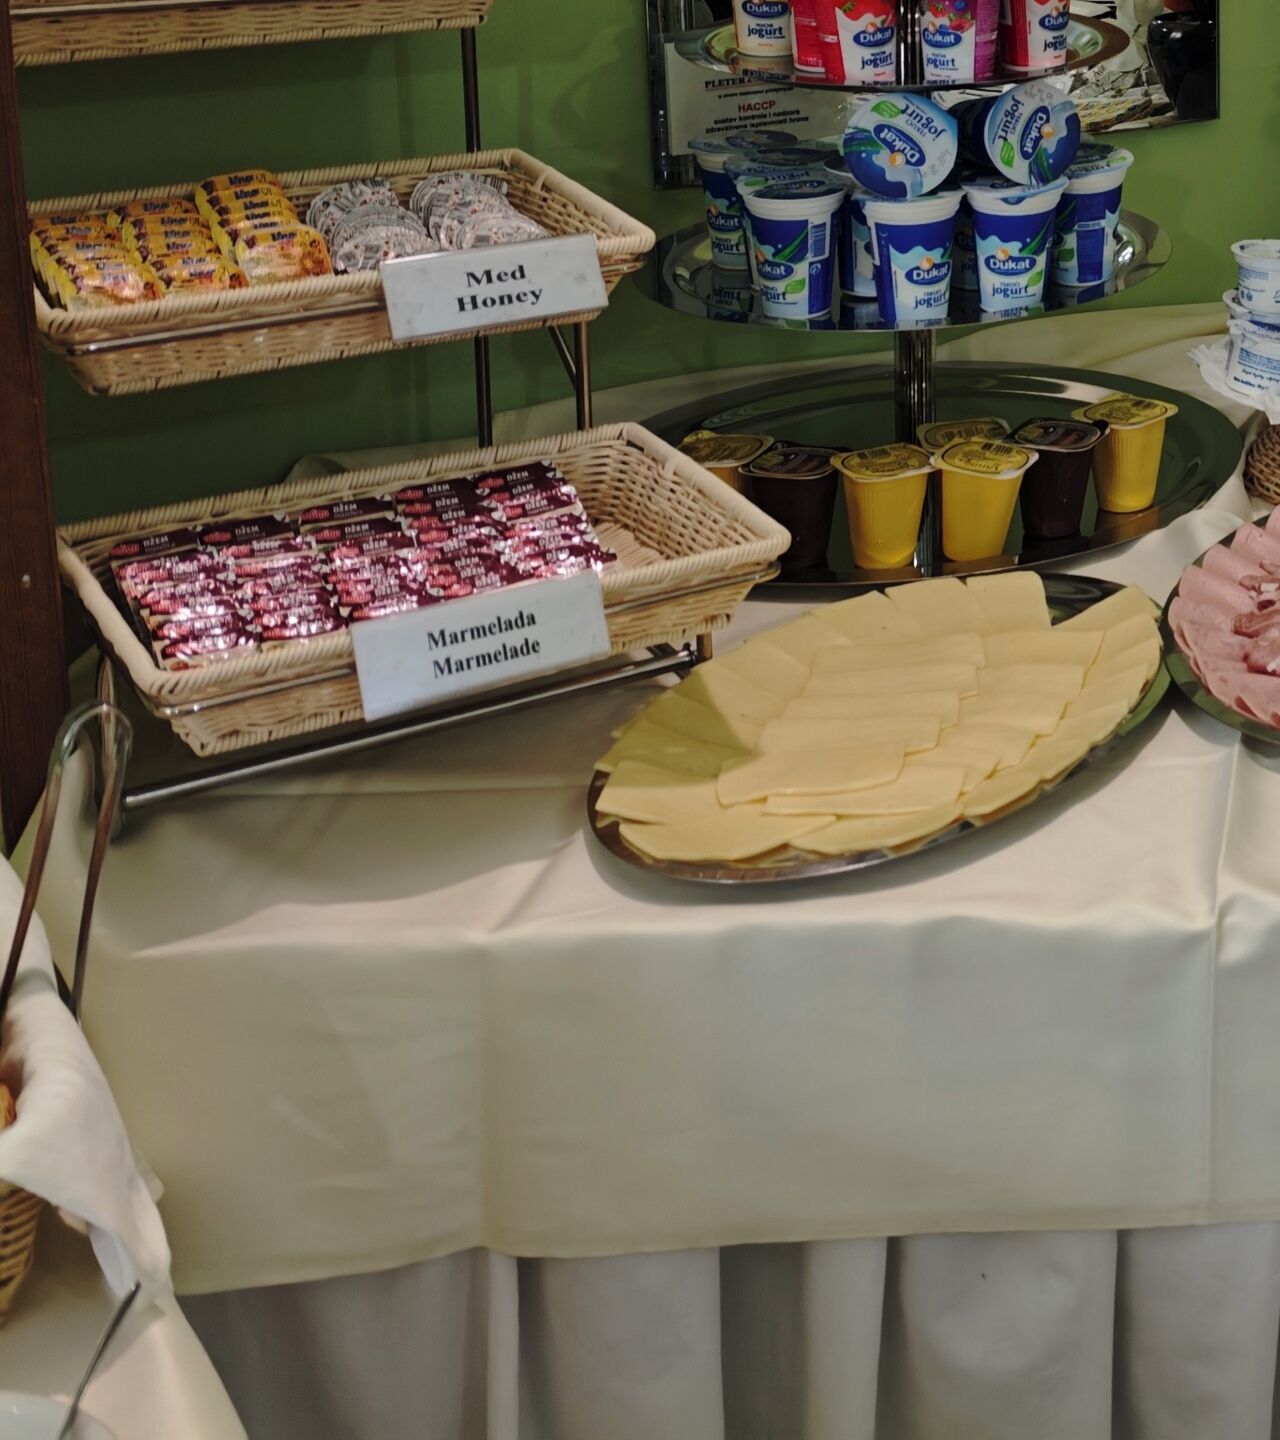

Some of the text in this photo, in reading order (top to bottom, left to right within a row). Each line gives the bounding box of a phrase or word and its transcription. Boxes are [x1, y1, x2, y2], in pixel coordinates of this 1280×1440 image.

[747, 1, 783, 13] Dukat
[748, 26, 783, 39] jogurt
[860, 30, 892, 43] Dukat
[924, 32, 955, 43] Dukat
[861, 53, 893, 69] jogurt
[926, 57, 956, 69] jogurt
[738, 100, 776, 113] HACCP
[714, 116, 738, 125] sustav
[738, 113, 768, 123] kontrole
[772, 109, 800, 118] nadzora
[901, 104, 948, 141] jogurt
[998, 95, 1025, 141] jogurt
[1024, 112, 1047, 154] Dukat
[880, 128, 921, 163] Dukat
[989, 258, 1031, 270] Dukat
[465, 265, 527, 288] Med
[913, 265, 948, 280] Dukat
[992, 283, 1029, 299] jogurt
[456, 288, 543, 312] Honey
[914, 292, 947, 309] jogurt
[507, 470, 530, 481] DŽEM
[427, 483, 450, 494] DŽEM
[512, 483, 534, 494] DŽEM
[333, 503, 357, 513] DŽEM
[436, 496, 459, 507] DŽEM
[525, 499, 548, 511] DŽEM
[442, 509, 466, 521] DŽEM
[235, 524, 259, 537] DŽEM
[345, 523, 369, 533] DŽEM
[452, 524, 476, 535] DŽEM
[143, 535, 168, 547] DŽEM
[363, 539, 388, 550] DŽEM
[461, 566, 486, 579] DŽEM
[427, 610, 537, 651] Marmelada
[432, 637, 541, 679] Marmelade
